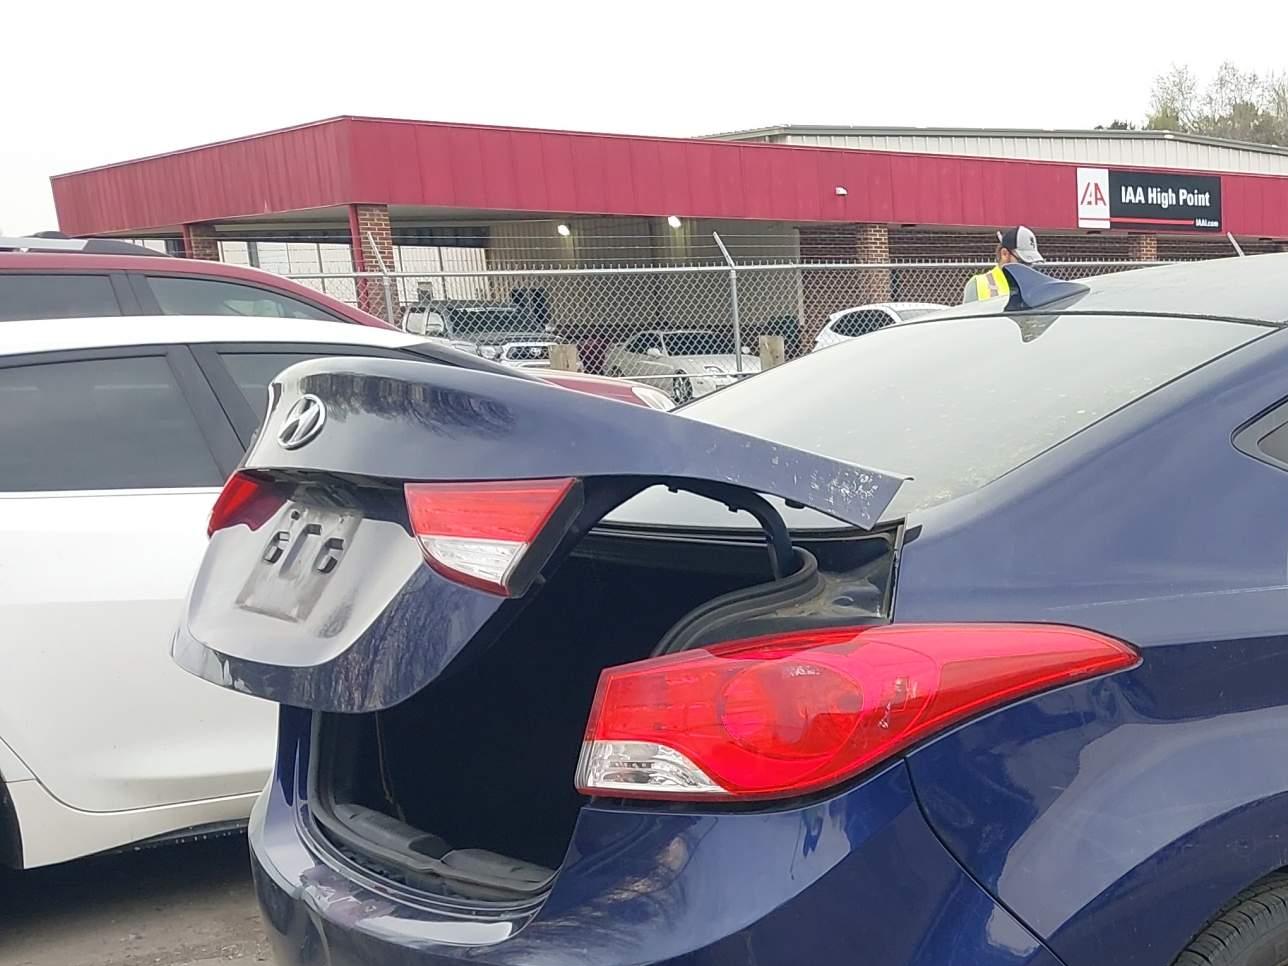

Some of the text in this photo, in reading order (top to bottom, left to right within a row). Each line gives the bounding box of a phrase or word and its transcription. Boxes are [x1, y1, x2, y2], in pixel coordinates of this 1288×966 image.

[1121, 185, 1211, 209] IAA High Point
